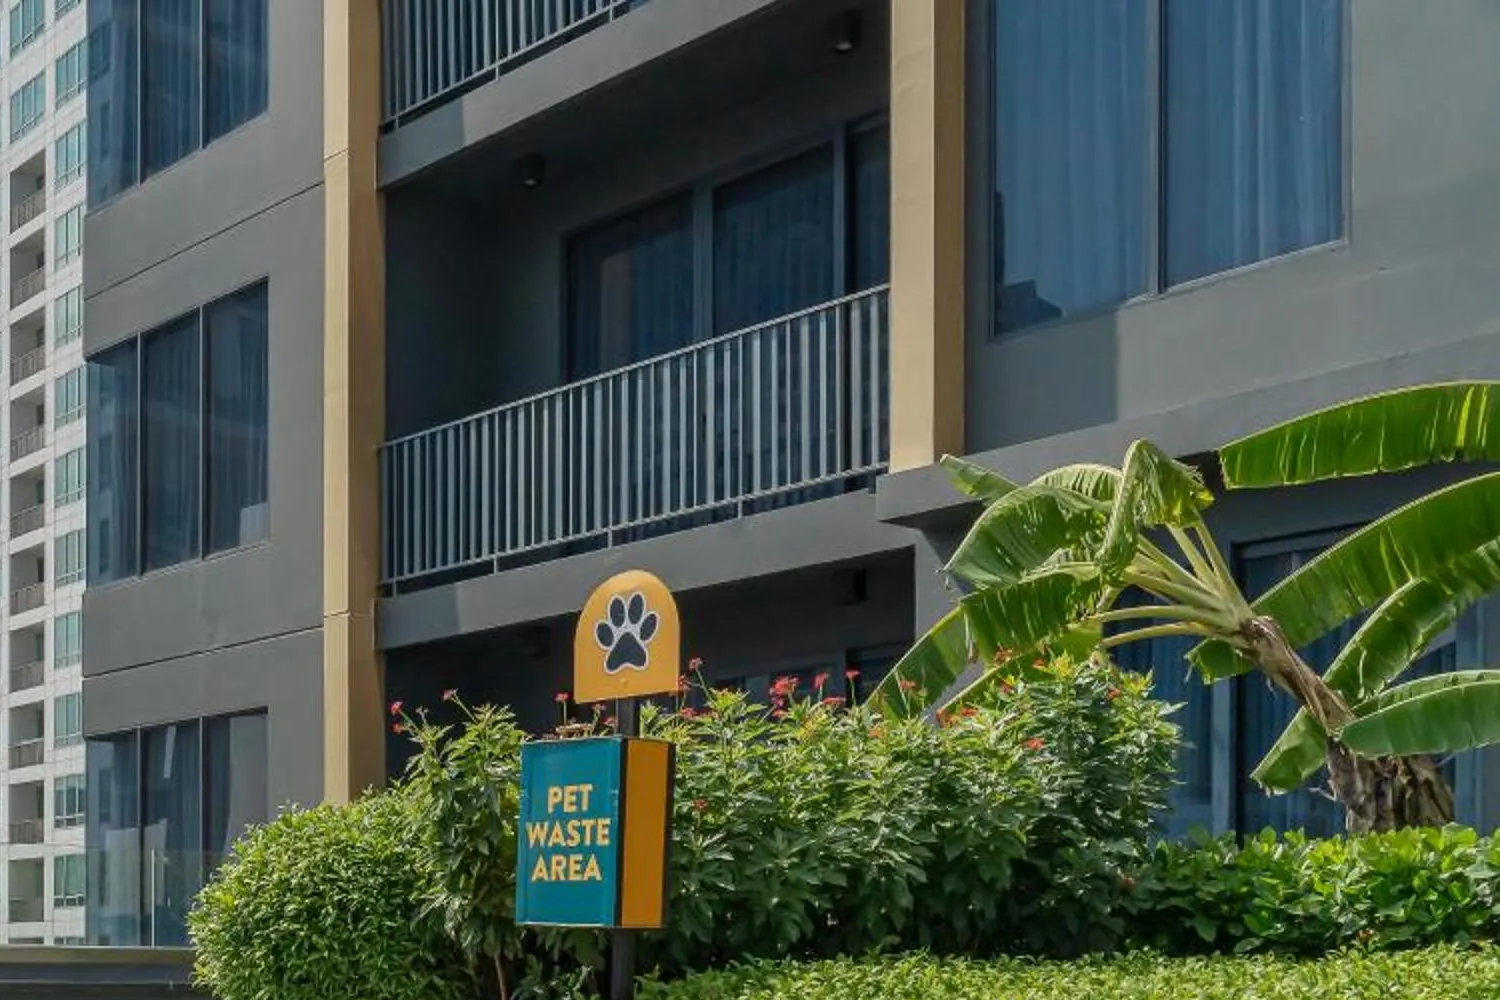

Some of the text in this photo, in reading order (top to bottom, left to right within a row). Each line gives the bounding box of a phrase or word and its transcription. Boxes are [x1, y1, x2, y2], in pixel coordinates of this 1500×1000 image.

[547, 783, 593, 813] PET
[526, 817, 611, 848] WASTE
[531, 853, 602, 881] AREA
